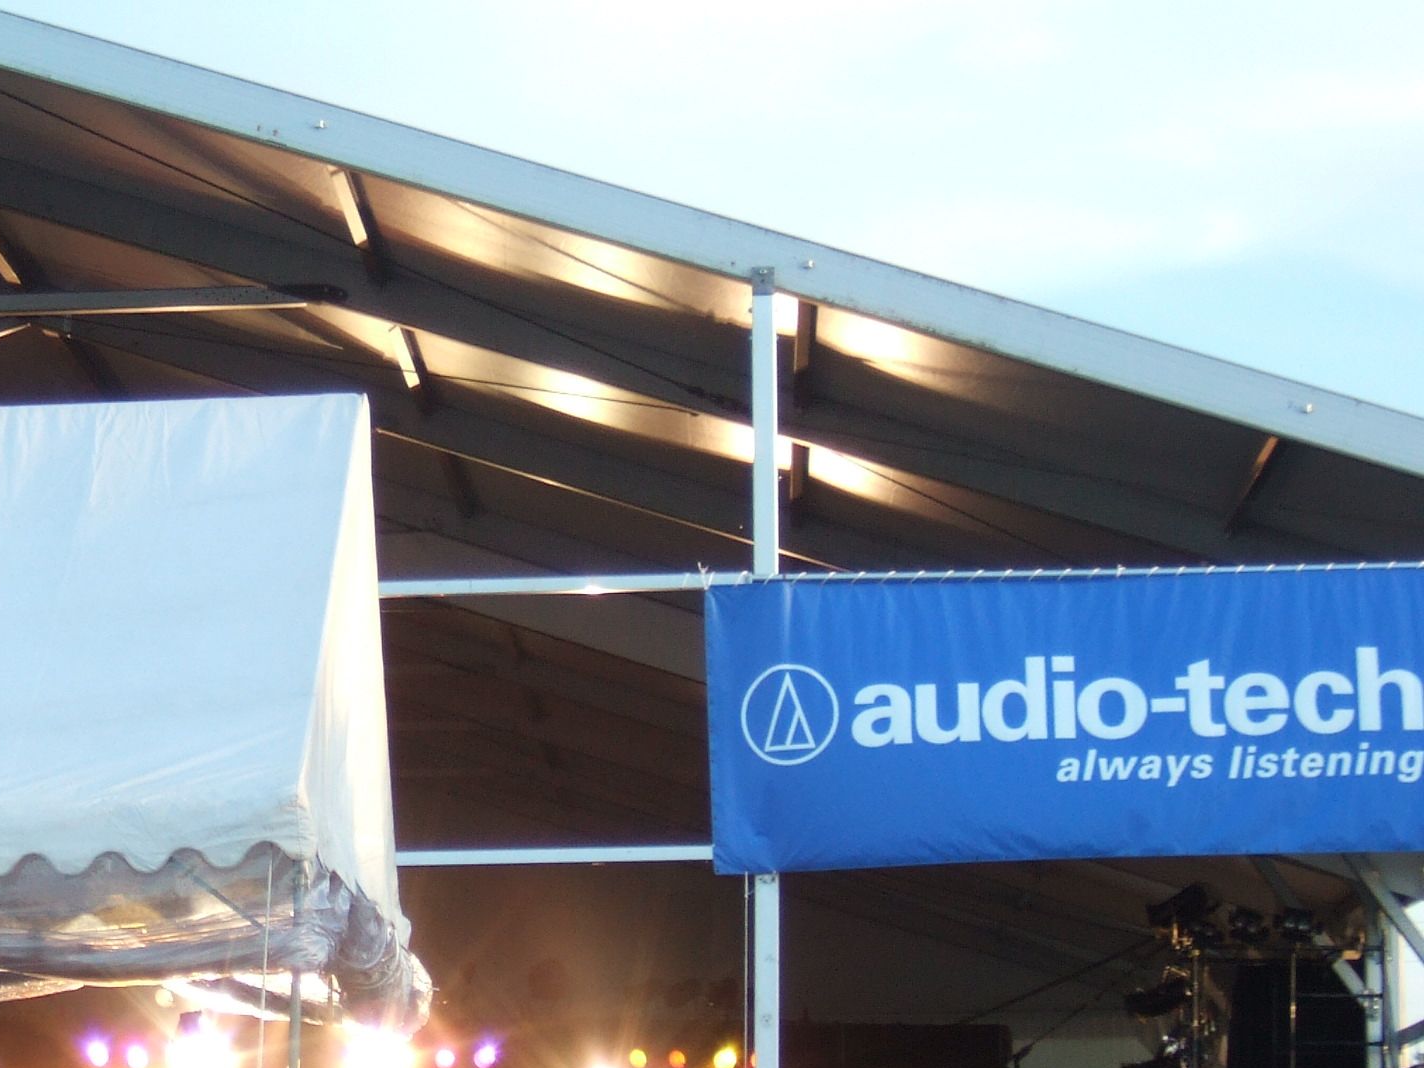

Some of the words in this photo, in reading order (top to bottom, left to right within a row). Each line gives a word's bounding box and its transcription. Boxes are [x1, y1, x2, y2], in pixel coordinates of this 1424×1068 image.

[851, 647, 1424, 748] audio-tech
[1056, 749, 1214, 788] always
[1228, 742, 1424, 783] listening
